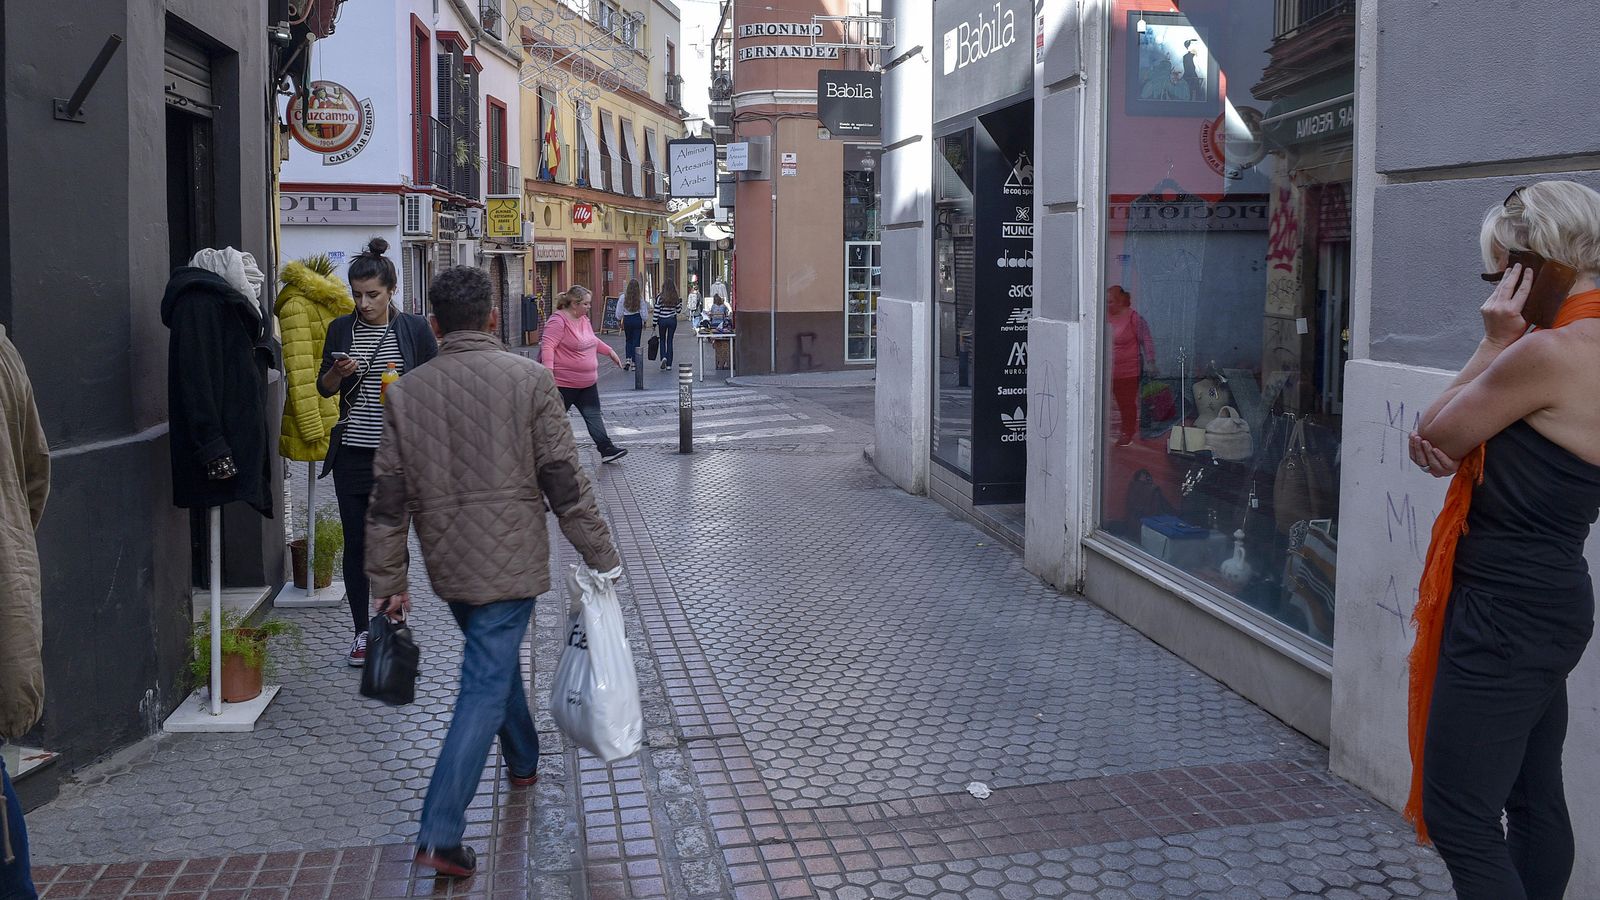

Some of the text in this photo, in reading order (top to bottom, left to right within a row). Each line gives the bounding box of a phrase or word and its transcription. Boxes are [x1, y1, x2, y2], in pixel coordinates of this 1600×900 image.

[738, 23, 823, 36] ERONIMO
[958, 1, 1016, 69] Babila
[826, 82, 874, 99] Babila
[294, 110, 355, 123] Cuzcampo
[329, 102, 373, 163] CAFÉ BAR REGINA
[677, 147, 708, 160] Alminar
[1010, 187, 1021, 195] coq
[574, 207, 591, 222] illy
